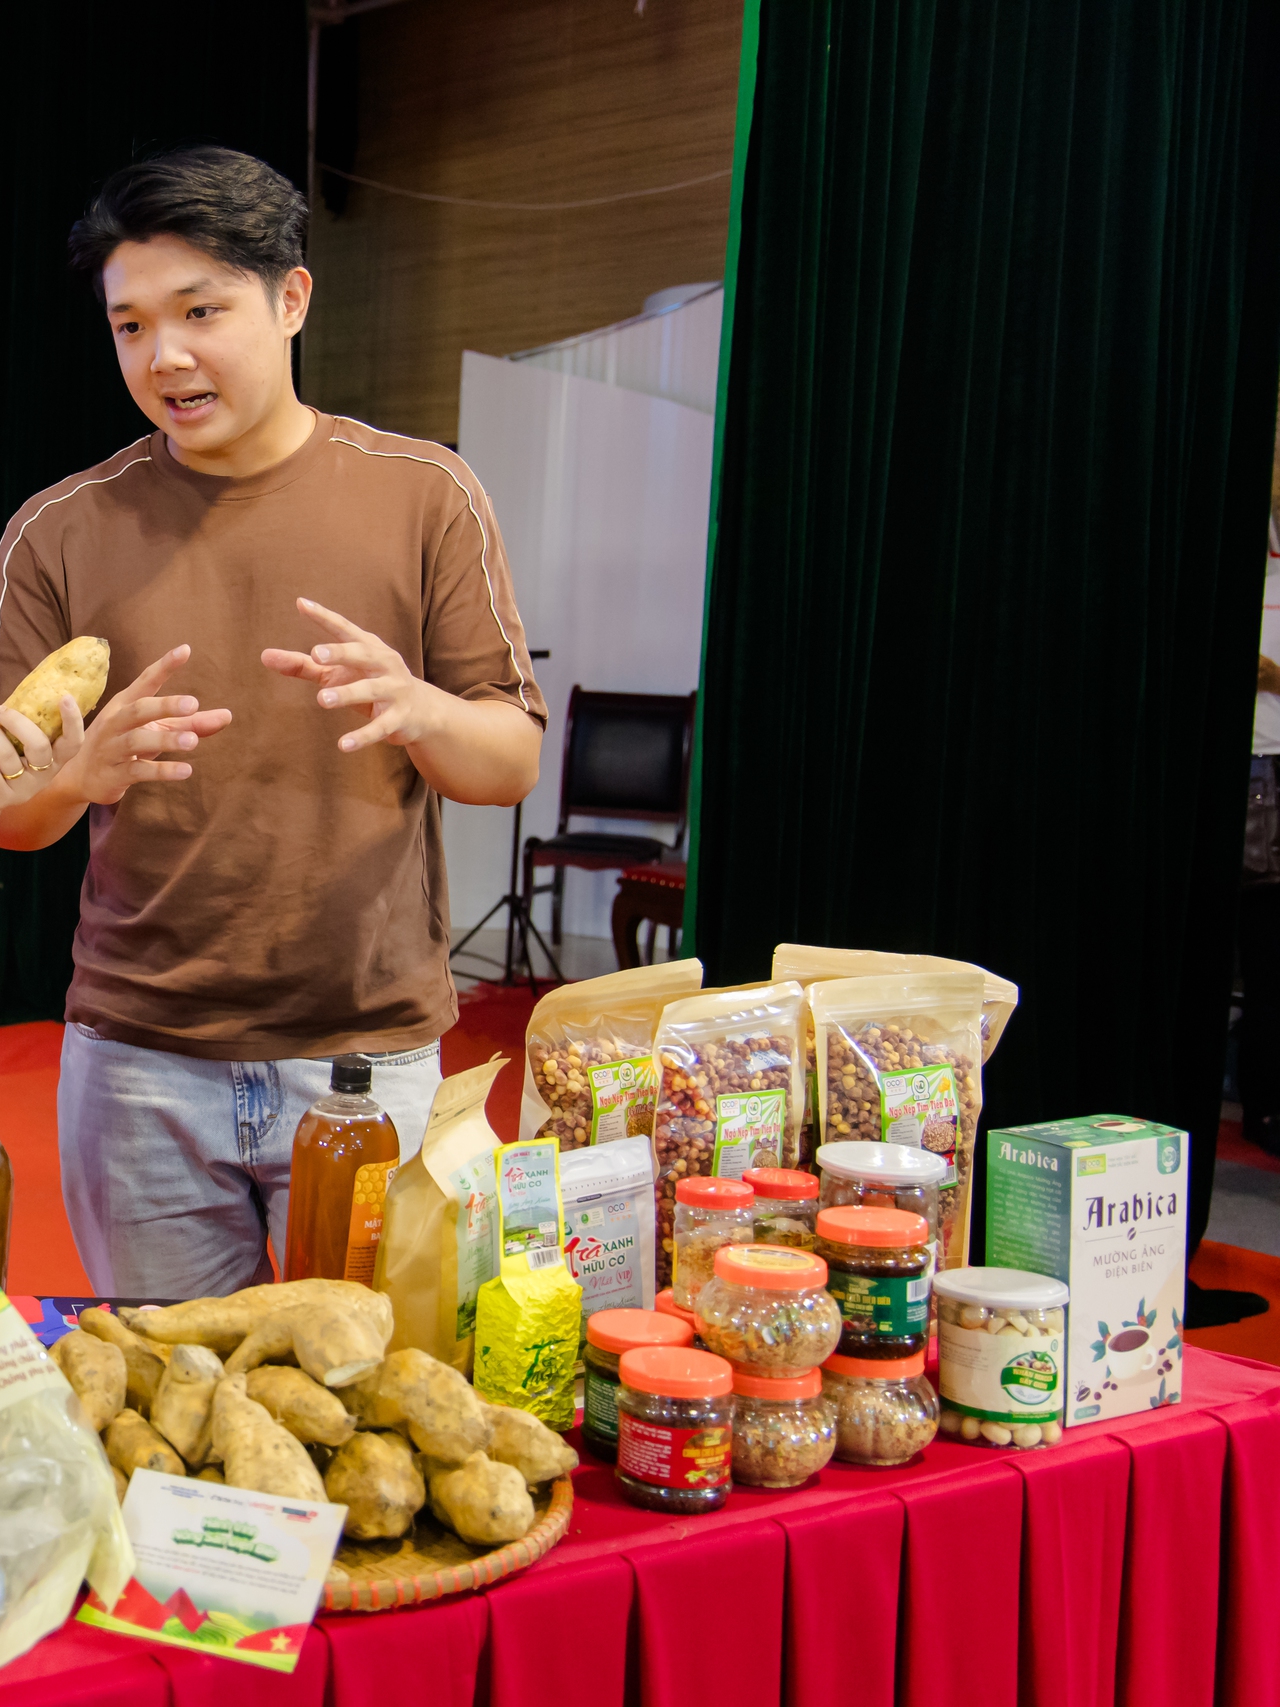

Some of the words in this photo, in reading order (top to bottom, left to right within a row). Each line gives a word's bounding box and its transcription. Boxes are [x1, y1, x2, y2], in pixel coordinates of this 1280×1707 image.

[998, 1141, 1059, 1172] Arabica
[524, 1169, 549, 1179] XANH
[608, 1202, 630, 1213] OCOP
[1083, 1192, 1177, 1231] Arabica
[564, 1236, 602, 1278] Trà
[602, 1236, 634, 1253] XANH
[583, 1259, 605, 1274] HỮU
[608, 1253, 626, 1268] CƠ
[1093, 1249, 1138, 1266] MƯỜNG
[1105, 1266, 1128, 1279] ĐIỆN
[1131, 1261, 1153, 1274] BIÊN
